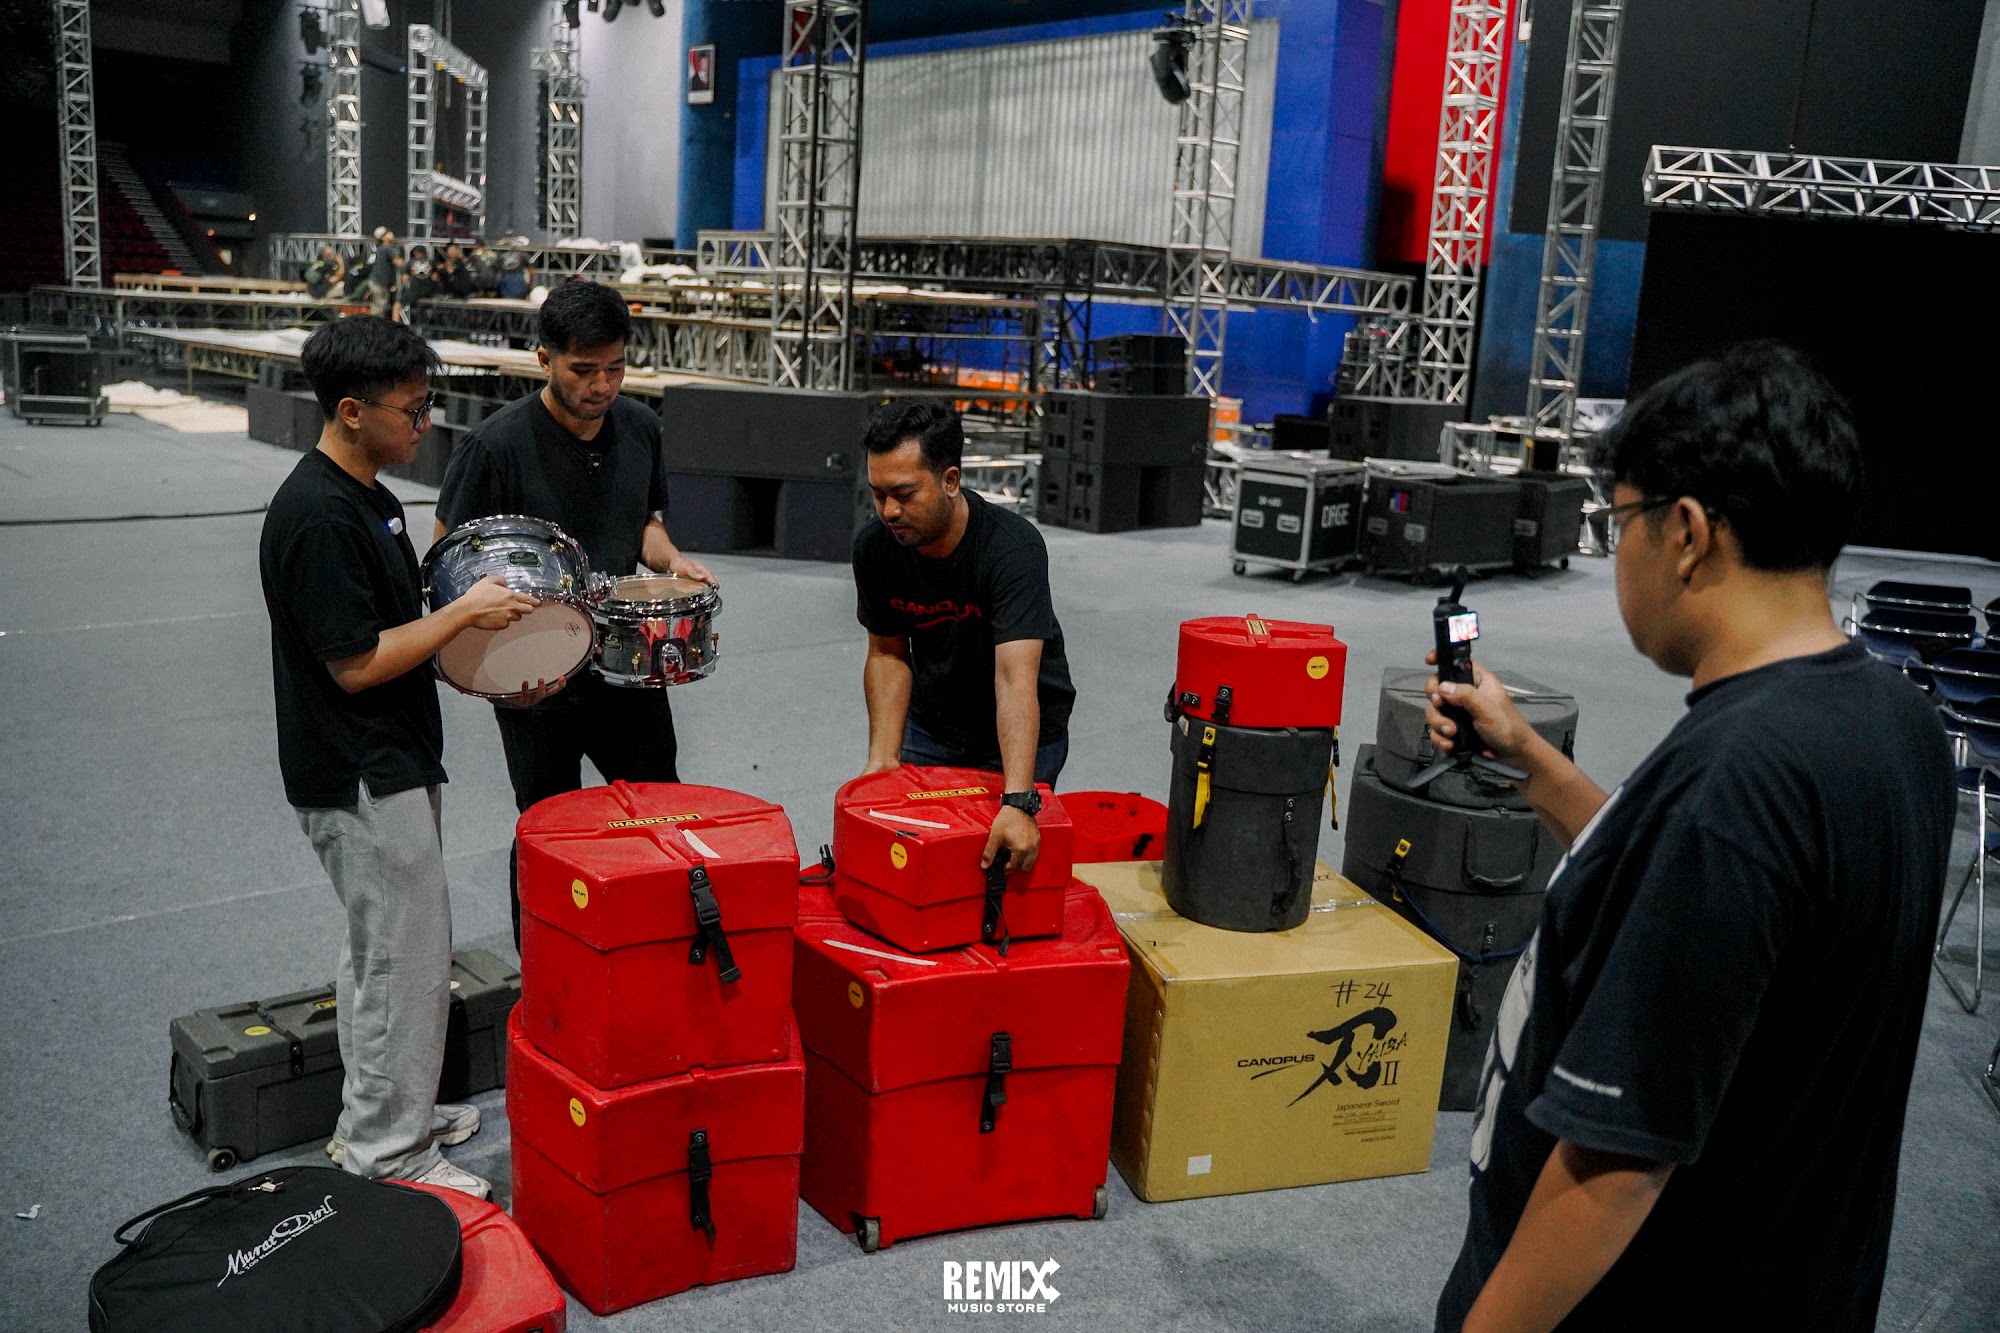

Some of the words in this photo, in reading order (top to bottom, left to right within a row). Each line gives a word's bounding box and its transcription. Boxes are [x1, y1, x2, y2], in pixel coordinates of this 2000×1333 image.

[611, 815, 698, 828] HARDCASE
[1330, 979, 1393, 1007] #24
[1237, 1054, 1315, 1068] CANOPUS
[1336, 1102, 1373, 1112] Japanese
[1374, 1097, 1401, 1107] Sword
[217, 1233, 277, 1288] Murat
[271, 1195, 333, 1238] Diril
